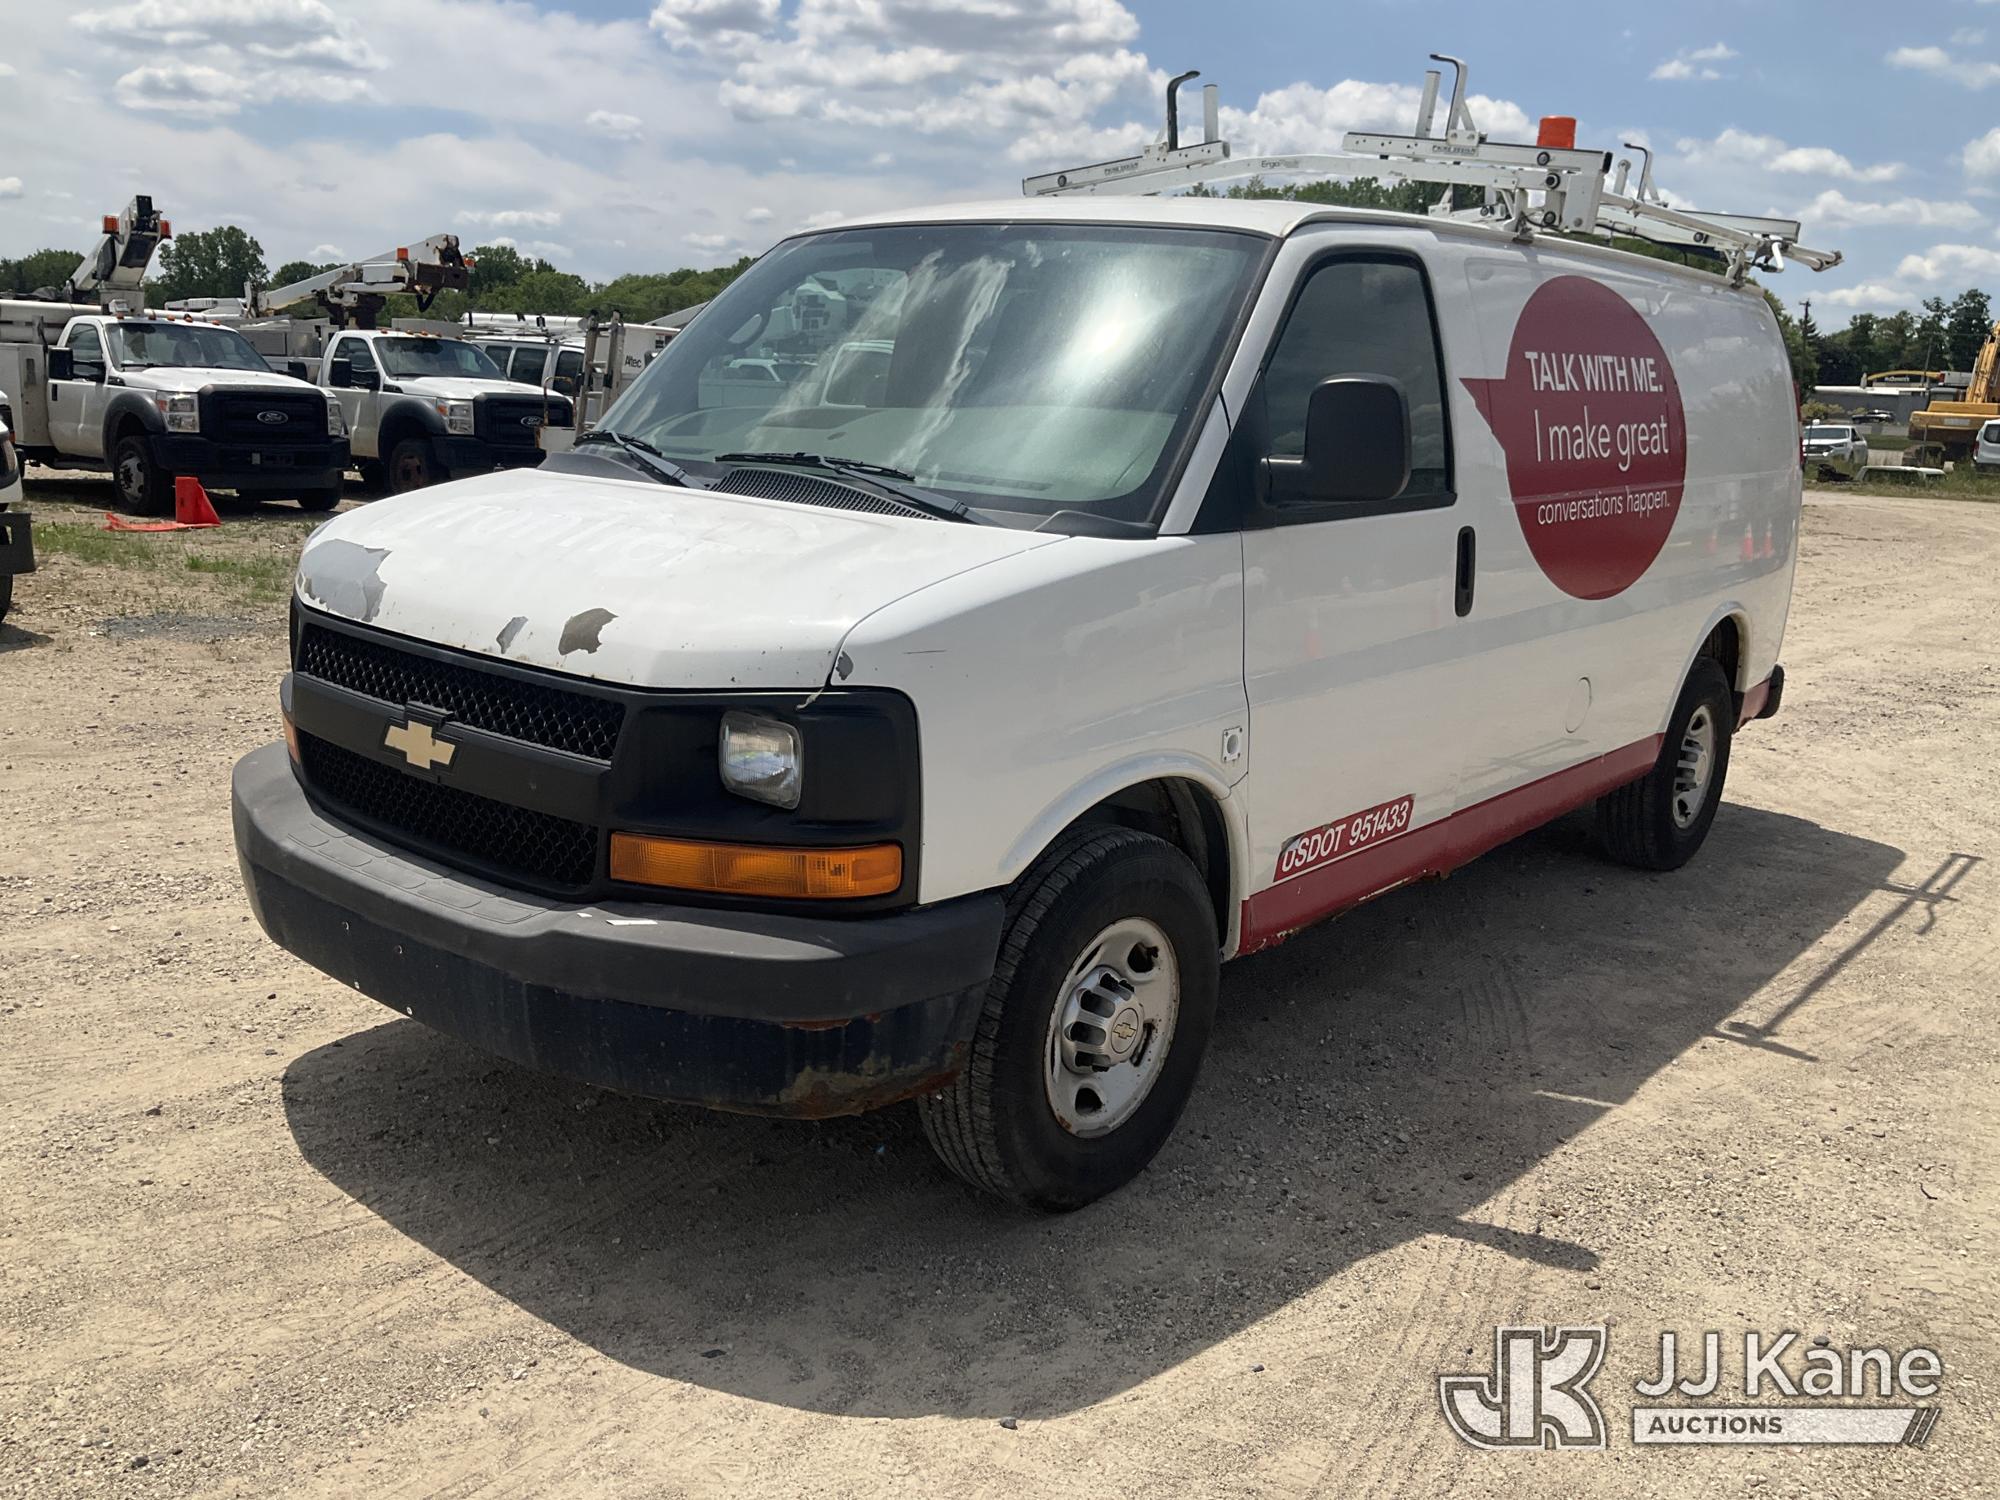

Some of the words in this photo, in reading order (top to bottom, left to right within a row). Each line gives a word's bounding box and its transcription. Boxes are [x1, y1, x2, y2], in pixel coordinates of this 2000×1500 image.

[1524, 352, 1579, 392] TALK
[1579, 354, 1629, 392] WITH
[1631, 357, 1663, 392] ME.
[1534, 409, 1541, 462] I
[1549, 406, 1611, 461] make
[1617, 414, 1669, 472] great
[1537, 492, 1623, 525] conversations
[1626, 485, 1670, 518] happen.
[1281, 823, 1346, 872] USDOT
[1349, 800, 1409, 846] 951433
